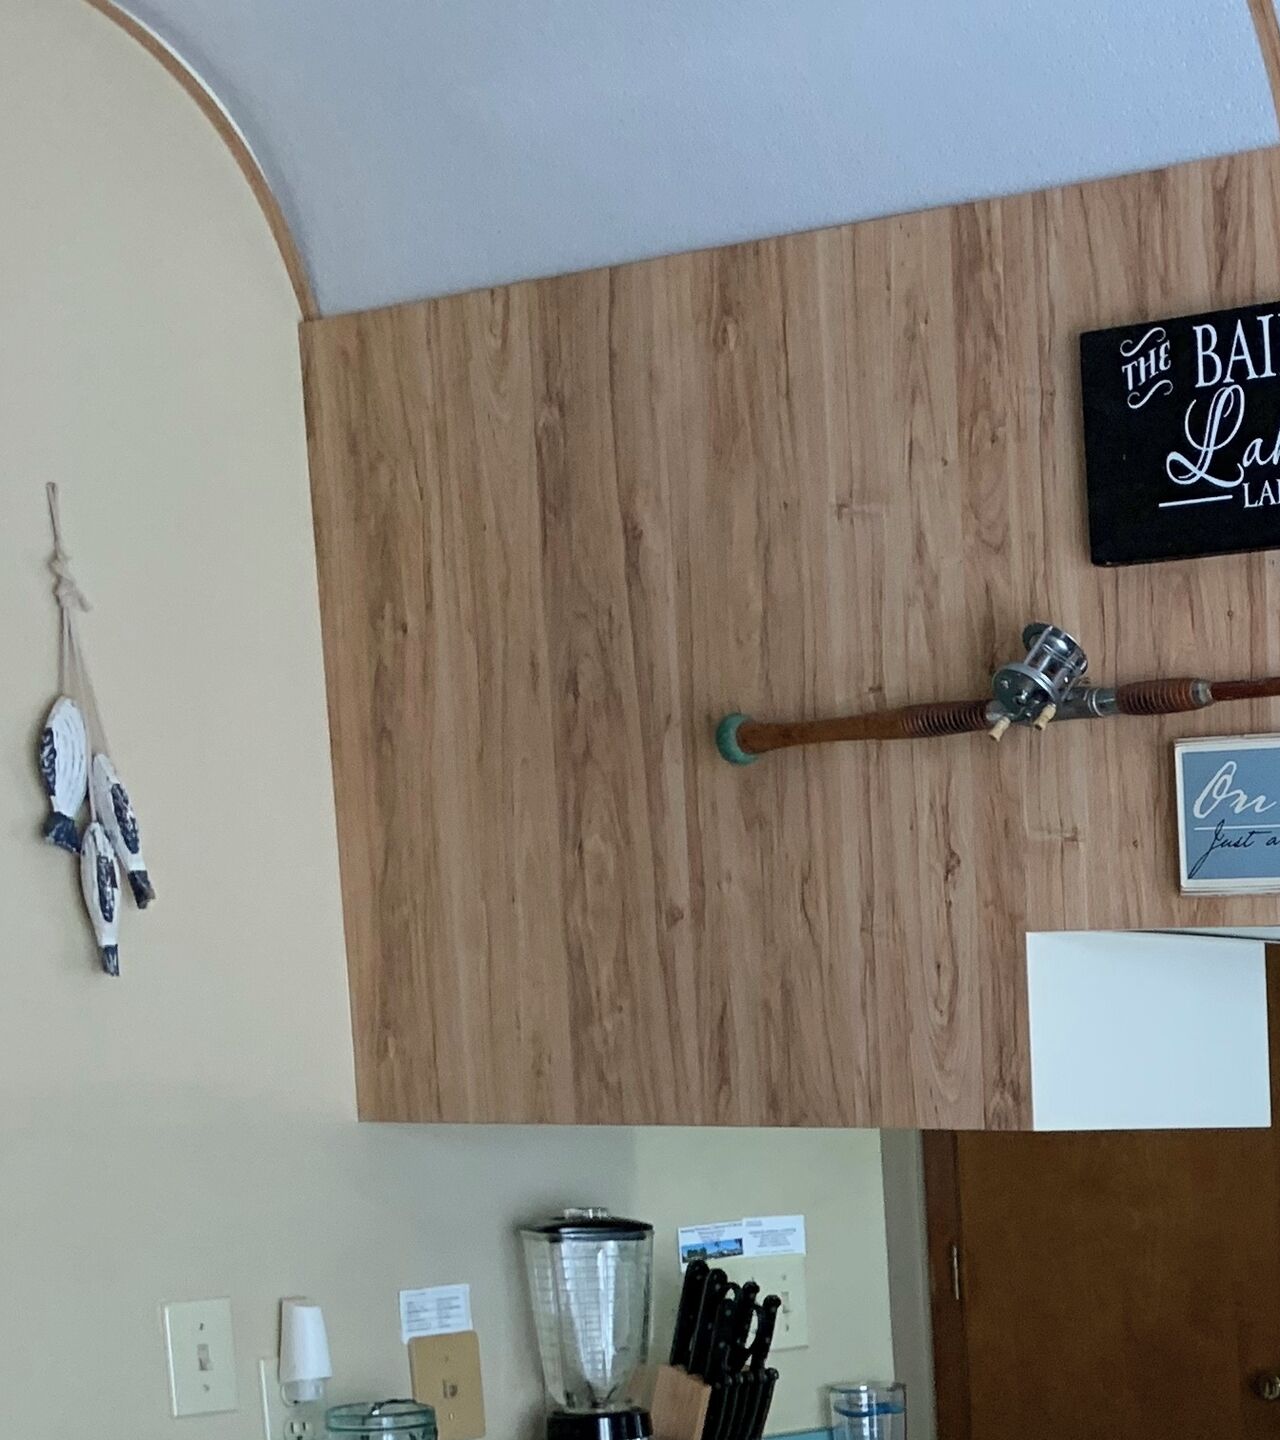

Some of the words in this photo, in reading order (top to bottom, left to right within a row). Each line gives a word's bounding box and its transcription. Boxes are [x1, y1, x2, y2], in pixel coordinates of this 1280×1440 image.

[1121, 341, 1171, 392] THE
[1193, 760, 1276, 819] On
[1188, 819, 1263, 880] Just
